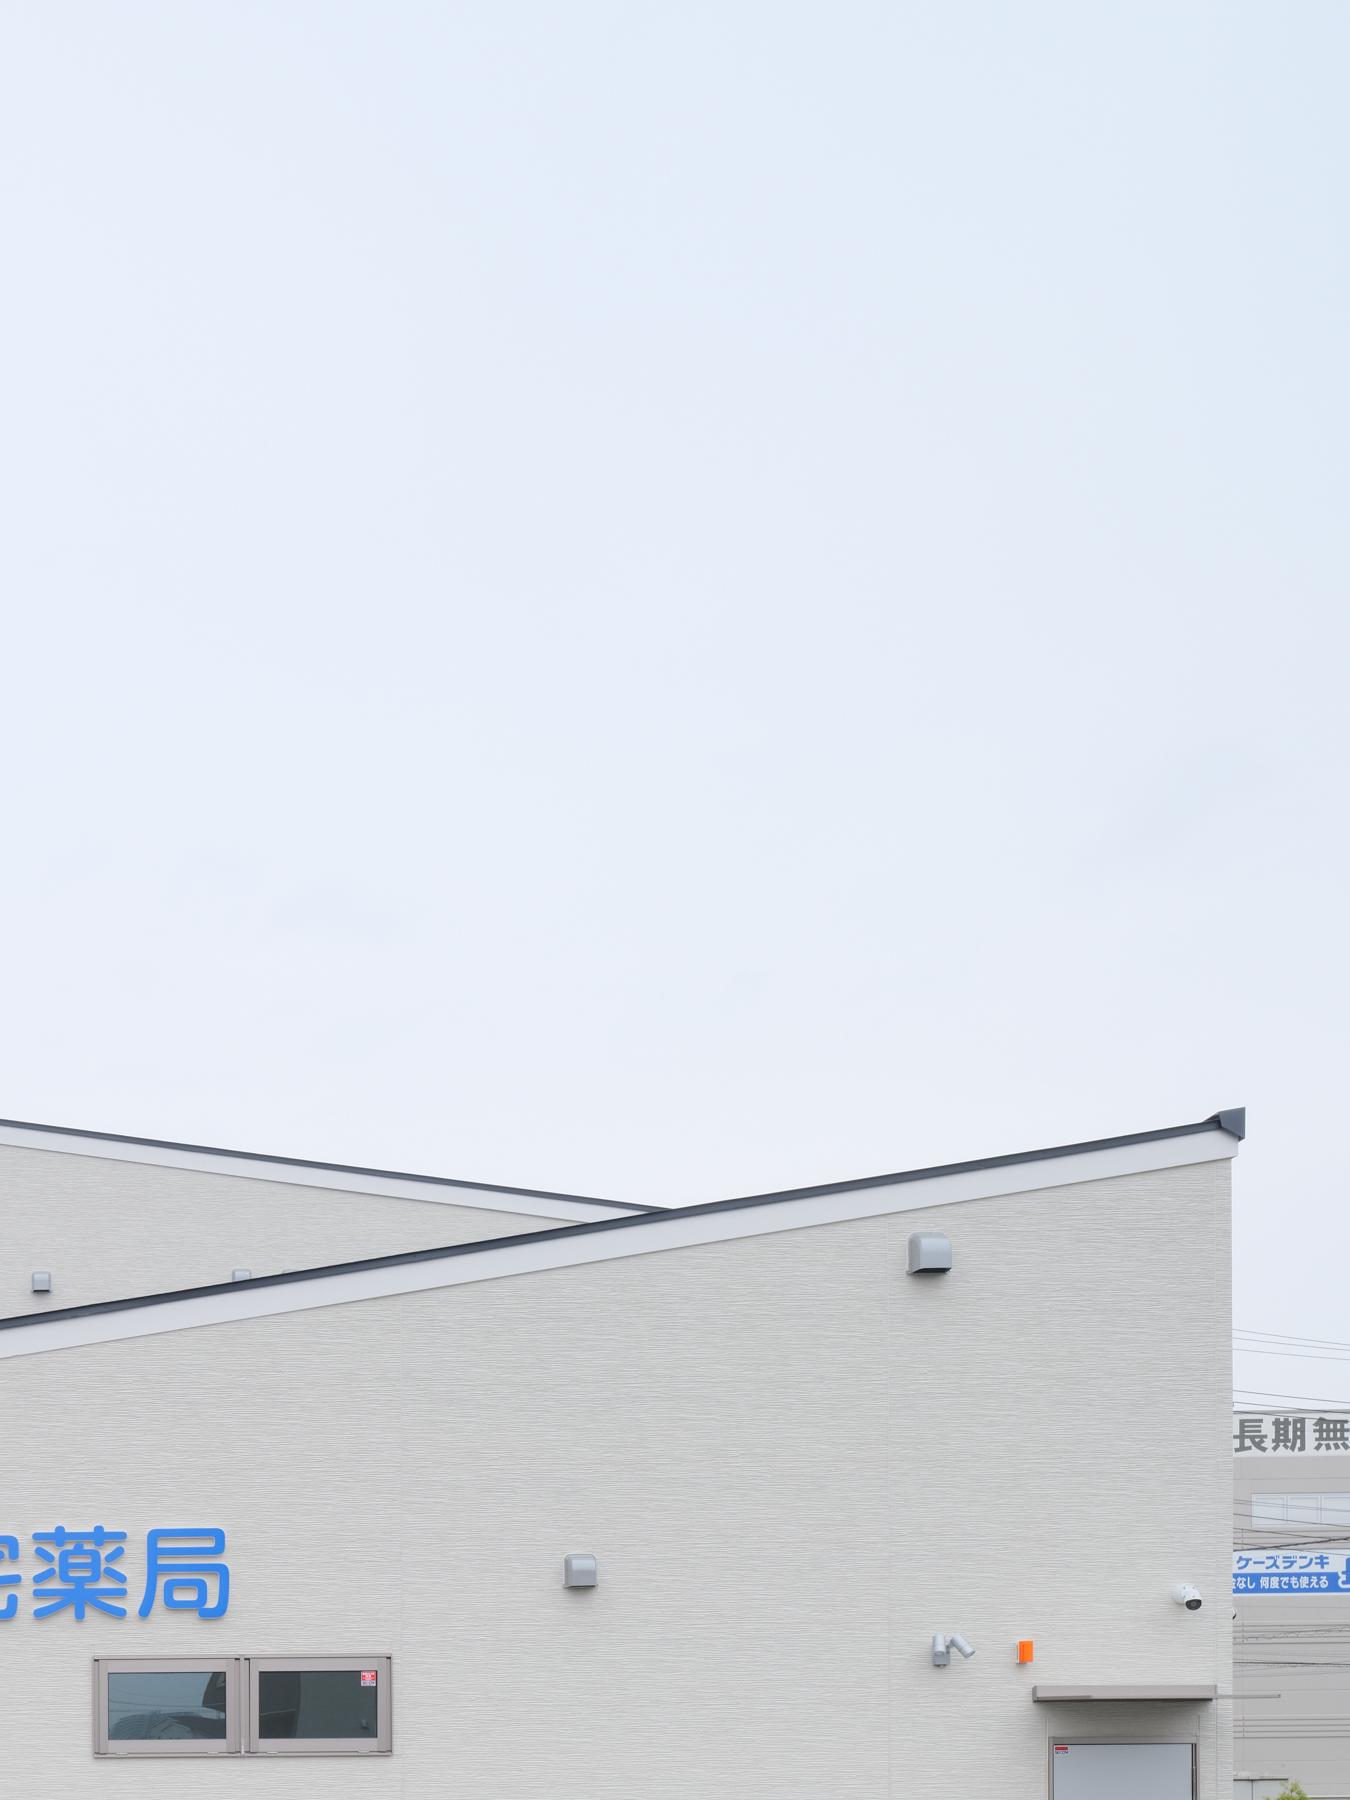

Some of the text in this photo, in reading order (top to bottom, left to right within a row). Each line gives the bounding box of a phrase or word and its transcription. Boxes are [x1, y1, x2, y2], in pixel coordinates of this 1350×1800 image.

[1233, 1417, 1350, 1453] 長期無
[1236, 1555, 1330, 1570] ケーズデンキ
[1260, 1576, 1329, 1589] 何度でも使える
